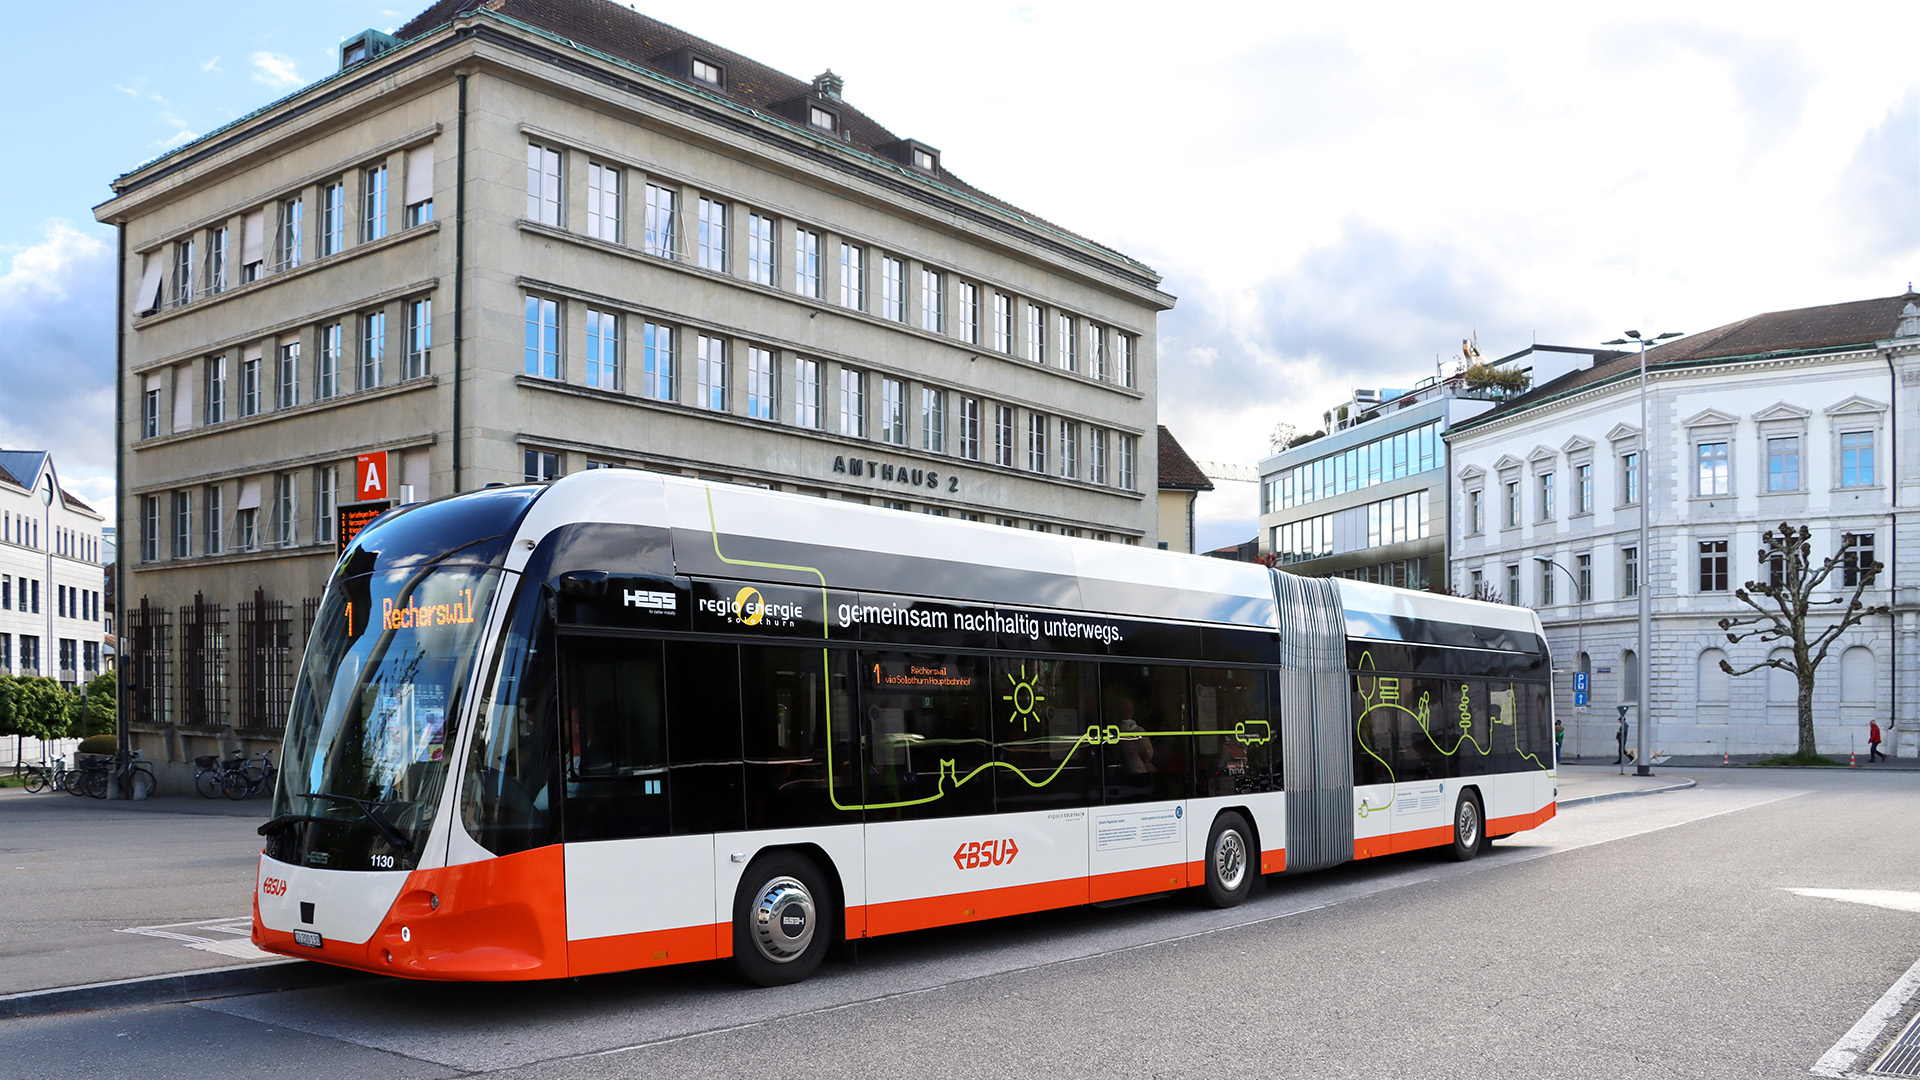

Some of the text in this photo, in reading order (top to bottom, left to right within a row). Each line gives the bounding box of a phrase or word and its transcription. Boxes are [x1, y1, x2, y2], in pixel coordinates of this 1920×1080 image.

[363, 462, 381, 493] A
[833, 455, 959, 493] AMTHAUS 2
[623, 588, 677, 610] HESS
[699, 597, 803, 621] regio energie
[344, 588, 475, 637] 1 Recherswil
[727, 615, 795, 628] solothurn
[838, 602, 1124, 645] gemeinsam nachhaltig unterwegs.
[873, 663, 947, 684] 1 Recherswil
[885, 675, 896, 684] via
[929, 677, 971, 686] Hauptbahnhof
[370, 854, 394, 869] 1130
